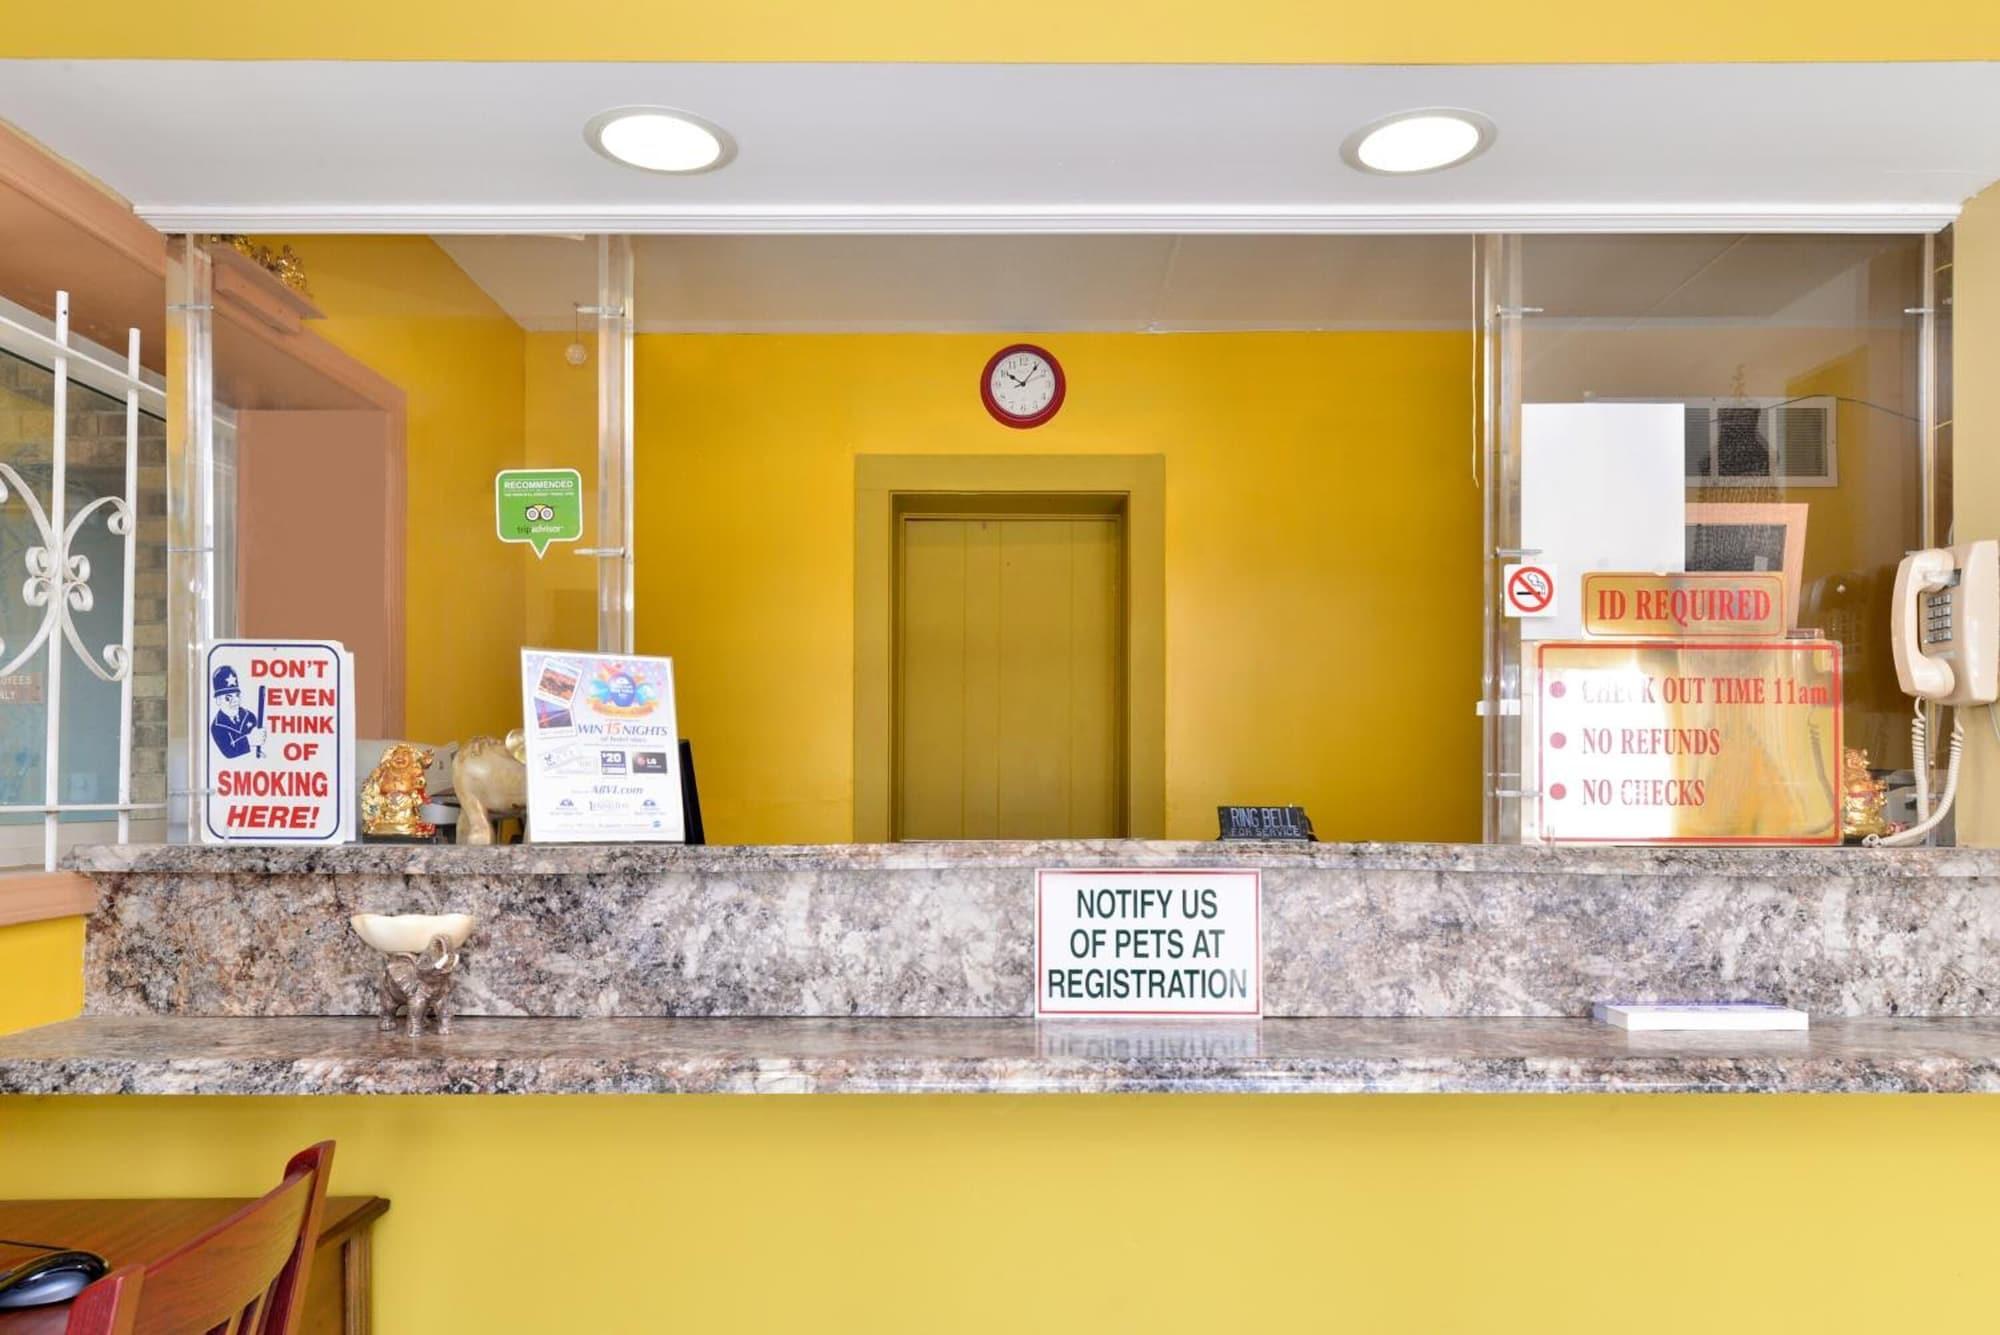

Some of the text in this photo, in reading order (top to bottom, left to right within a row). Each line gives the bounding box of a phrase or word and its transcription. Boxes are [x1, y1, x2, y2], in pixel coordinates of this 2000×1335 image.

[504, 480, 574, 489] RECOMMENDED
[1597, 588, 1772, 627] ID REQUIRED
[251, 659, 329, 679] DON'T
[267, 688, 336, 706] EVEN
[1662, 677, 1707, 704] OUT
[1712, 676, 1766, 704] TIME
[1774, 677, 1829, 705] 11am
[267, 715, 335, 734] THINK
[577, 722, 669, 737] WIN 15 NIGHTS
[283, 742, 319, 761] OF
[1582, 728, 1721, 756] NO REFUNDS
[217, 770, 329, 797] SMOKING
[1582, 779, 1706, 807] NO CHECKS
[226, 804, 321, 830] HERE!
[1230, 807, 1297, 829] RING BELL
[1231, 827, 1301, 837] FOR SERVICE
[1076, 888, 1218, 920] NOTIFY US
[1070, 928, 1226, 959] OF PETS AT
[1048, 968, 1248, 999] REGISTRATION
